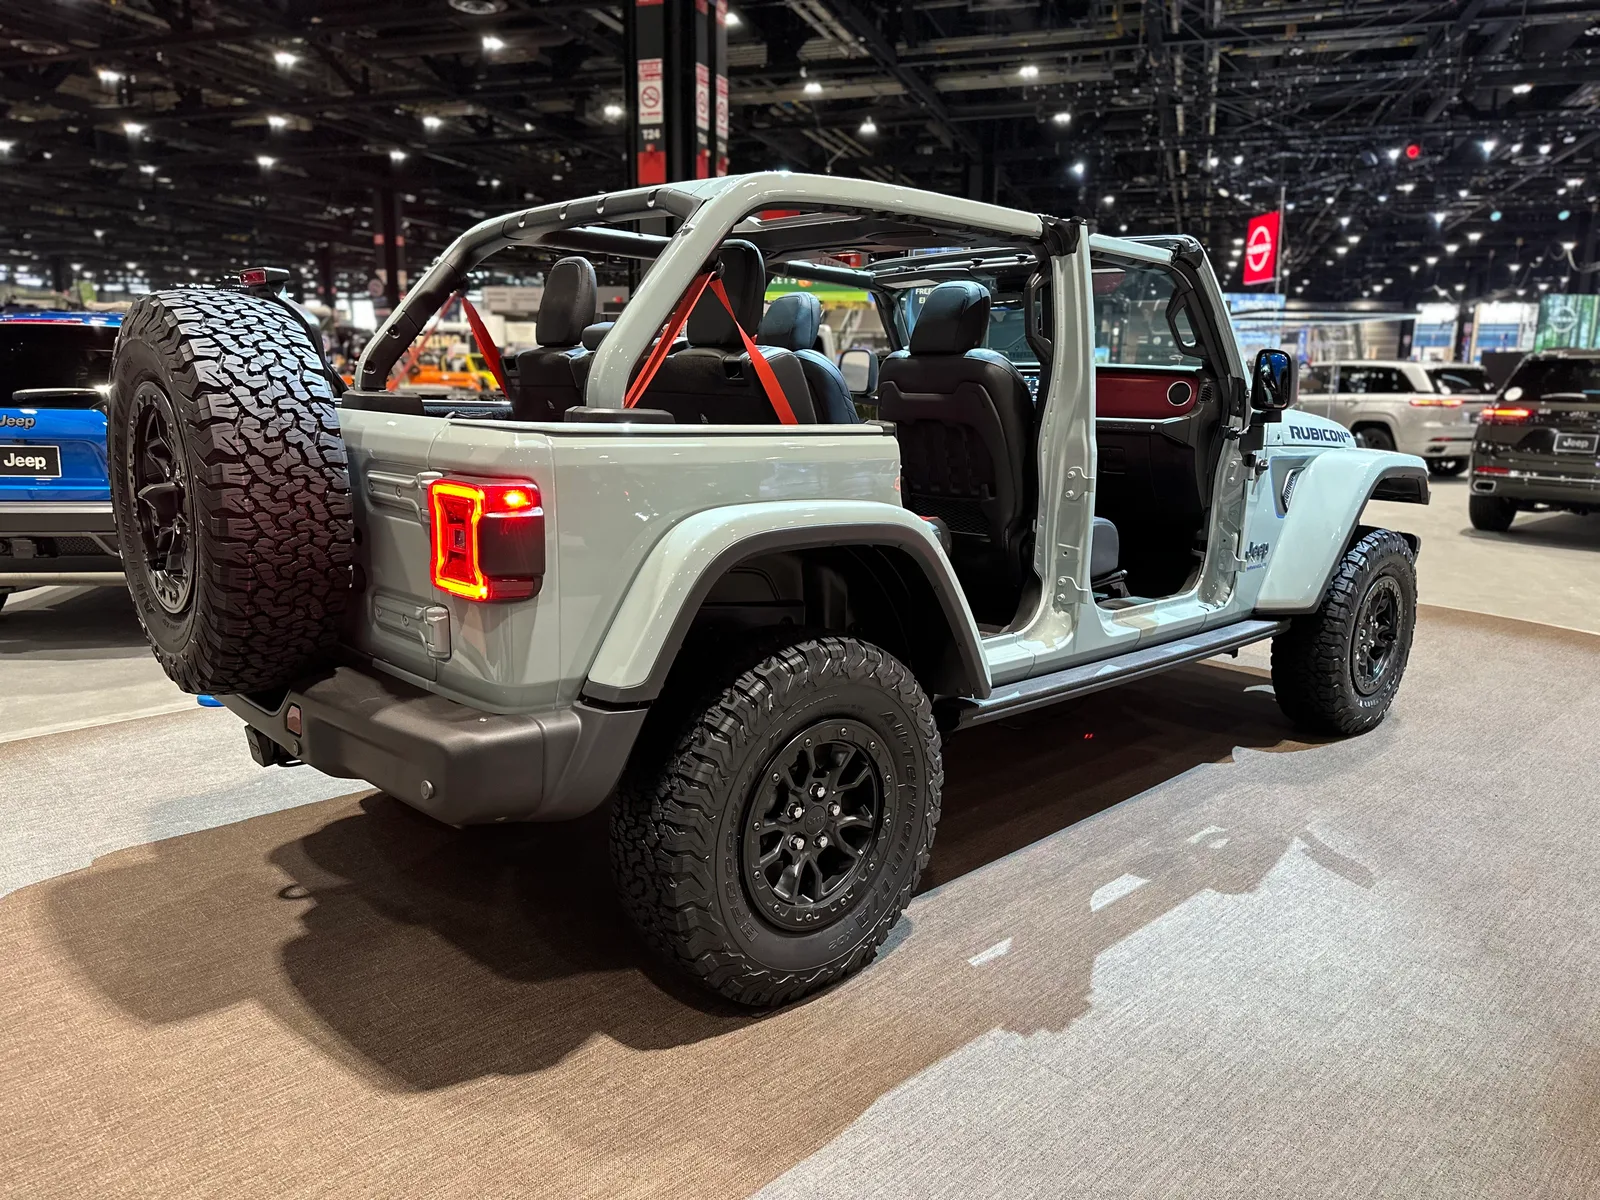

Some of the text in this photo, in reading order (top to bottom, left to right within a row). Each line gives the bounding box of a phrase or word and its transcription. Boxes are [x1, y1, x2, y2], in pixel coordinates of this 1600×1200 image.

[0, 415, 35, 429] Jeep
[1289, 425, 1346, 443] RUBICON
[1563, 438, 1589, 448] Jeep
[1245, 542, 1269, 560] Jeep
